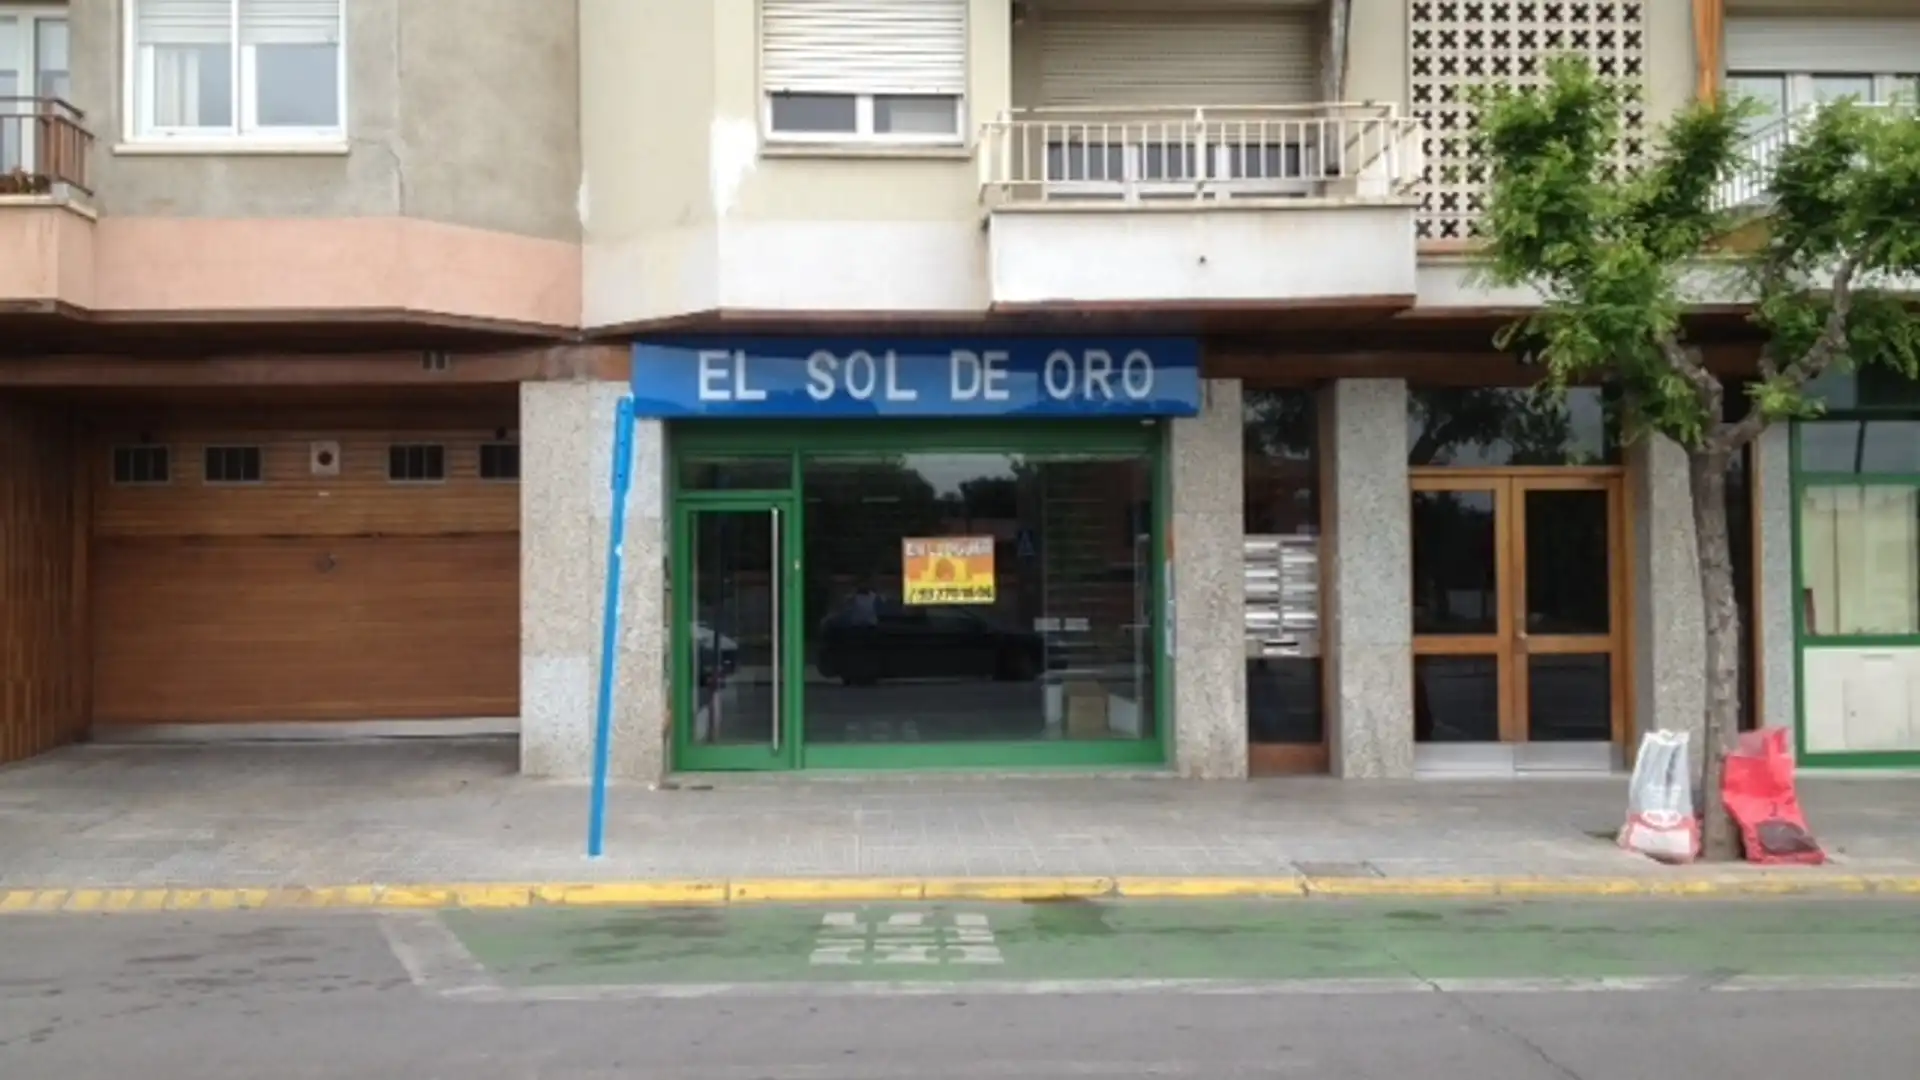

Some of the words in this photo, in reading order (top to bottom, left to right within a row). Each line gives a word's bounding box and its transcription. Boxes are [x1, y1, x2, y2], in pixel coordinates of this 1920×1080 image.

[698, 351, 765, 401] EL
[806, 351, 916, 401] SOL
[951, 351, 1010, 401] DE
[1043, 351, 1155, 401] ORO
